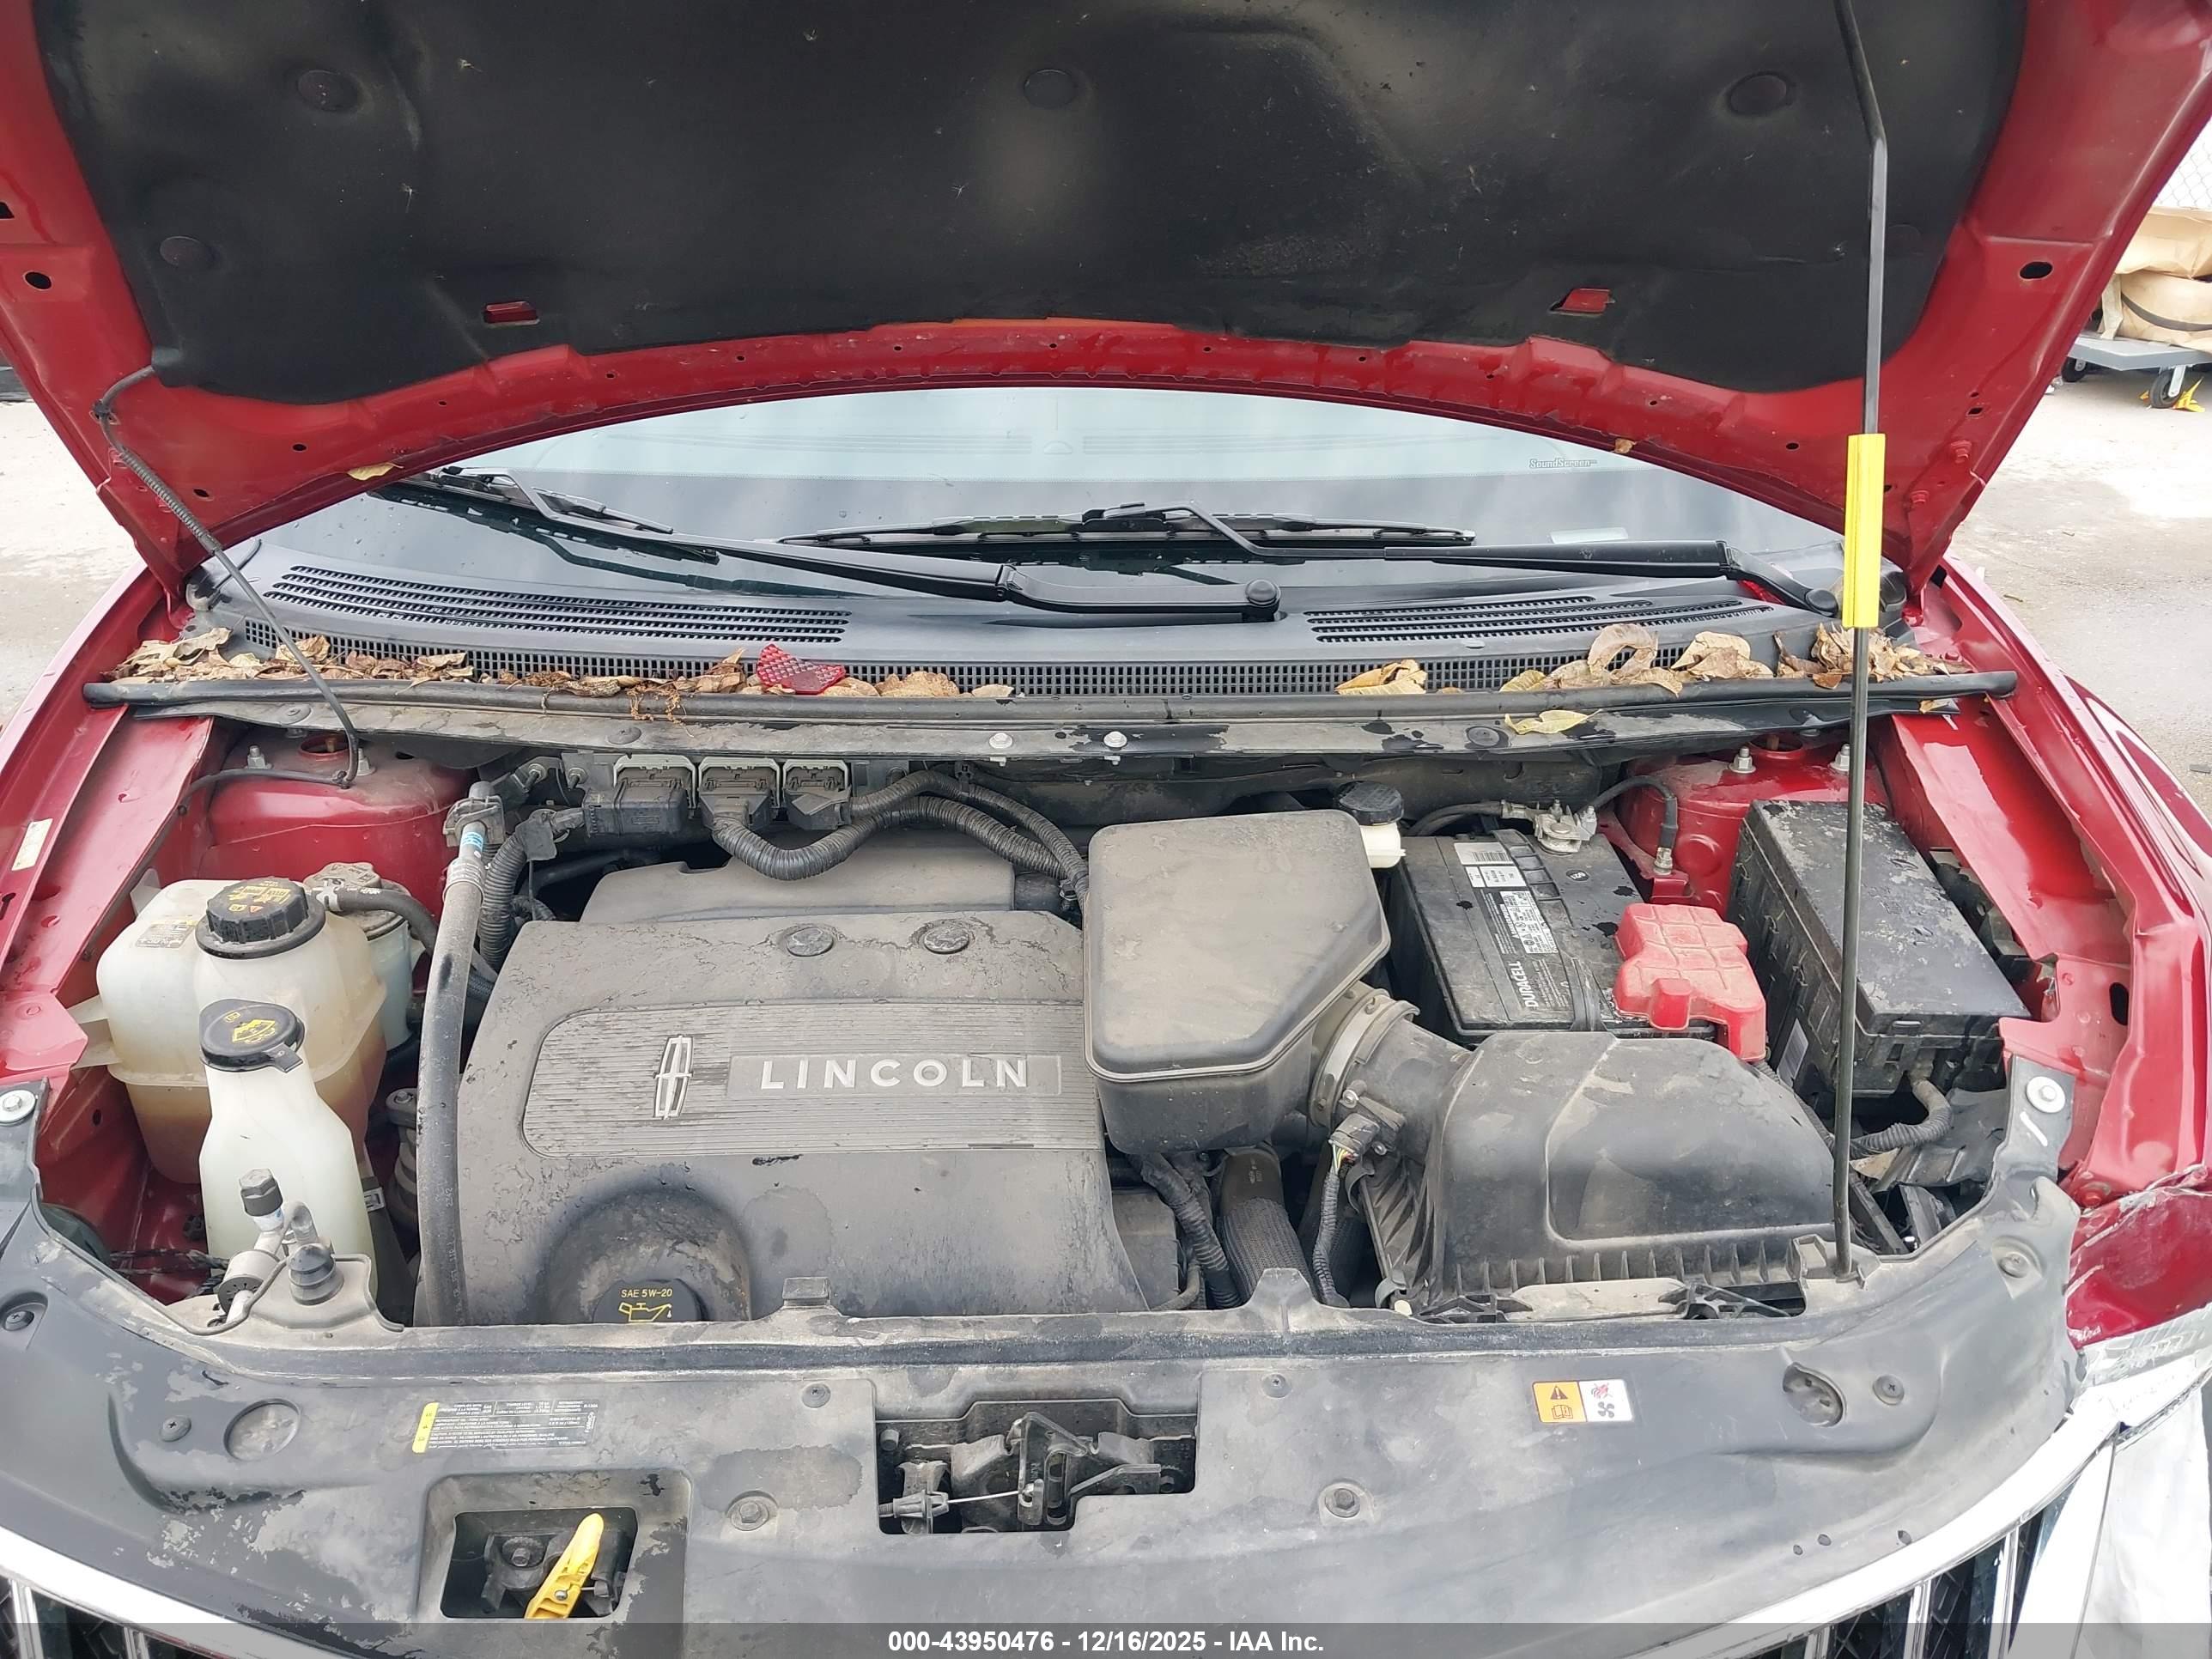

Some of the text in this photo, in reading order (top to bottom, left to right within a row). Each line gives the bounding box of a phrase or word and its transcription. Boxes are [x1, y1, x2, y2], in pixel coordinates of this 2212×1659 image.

[1508, 960, 1539, 1008] DURACELL
[761, 1058, 1028, 1090] LINCOLN
[621, 1288, 673, 1298] SAE 5W-20
